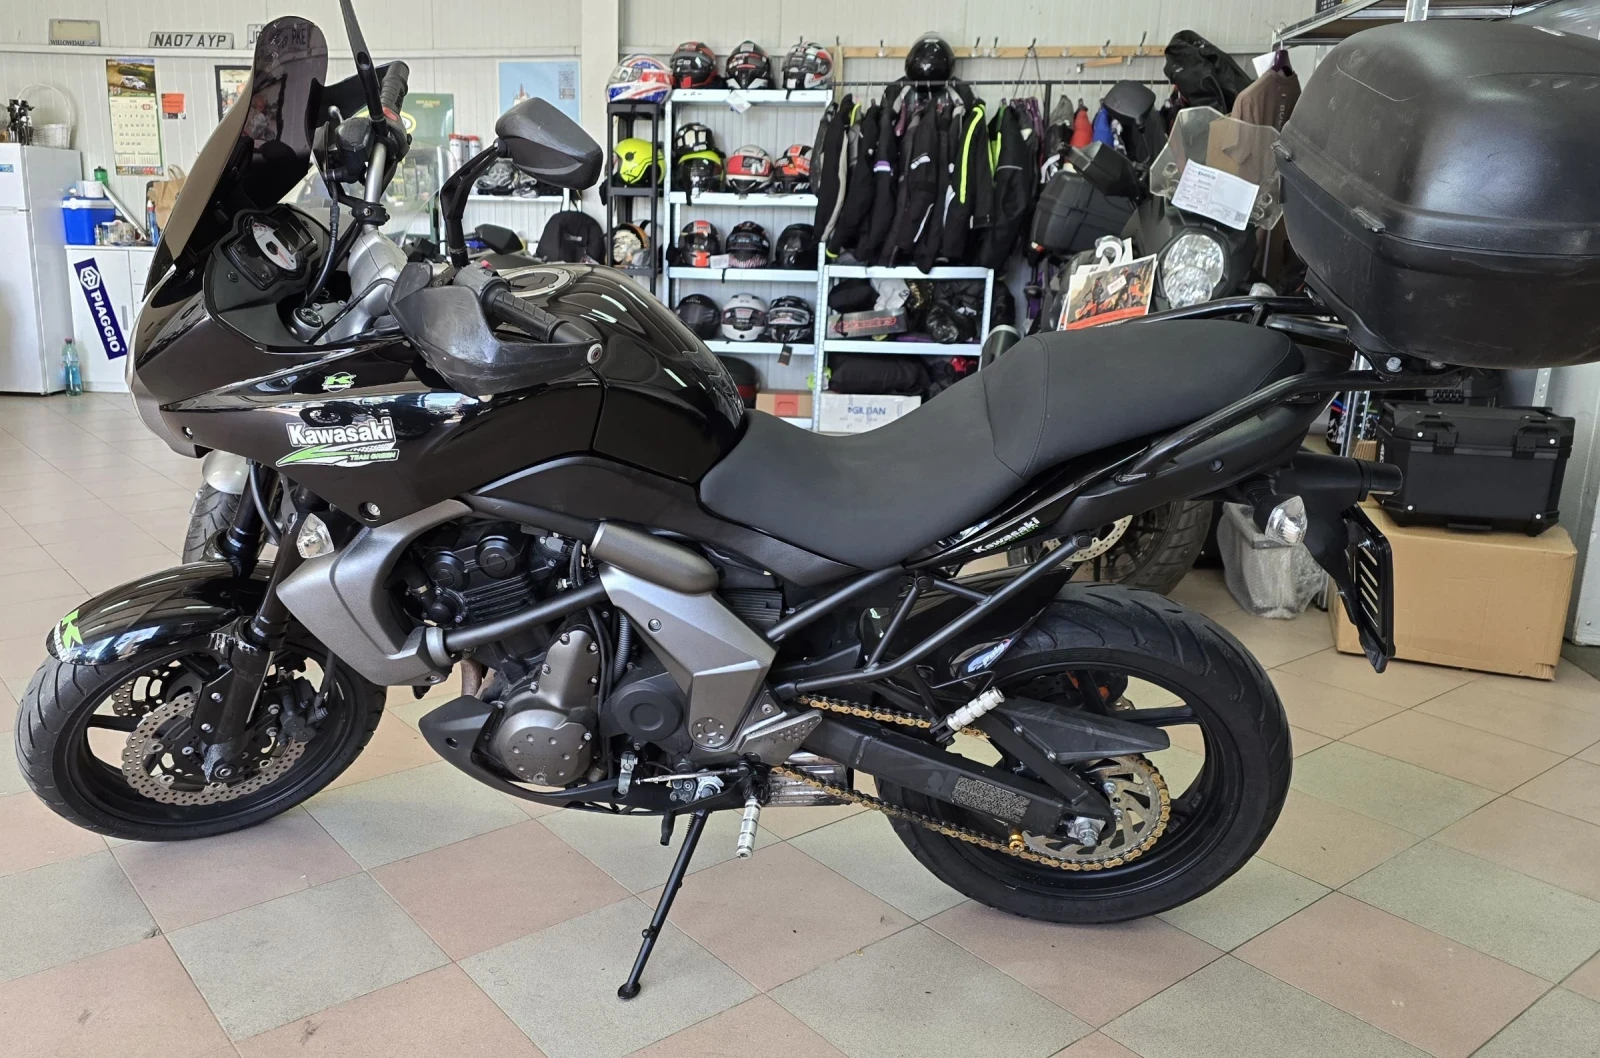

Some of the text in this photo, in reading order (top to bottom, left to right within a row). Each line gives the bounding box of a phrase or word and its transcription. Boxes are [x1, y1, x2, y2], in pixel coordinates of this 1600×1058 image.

[50, 39, 86, 47] WILLOWDALE
[153, 33, 227, 48] NA07 AYP
[90, 289, 121, 353] PIAGGIO
[287, 418, 395, 446] Kawasaki
[972, 517, 1040, 553] Kawasaki
